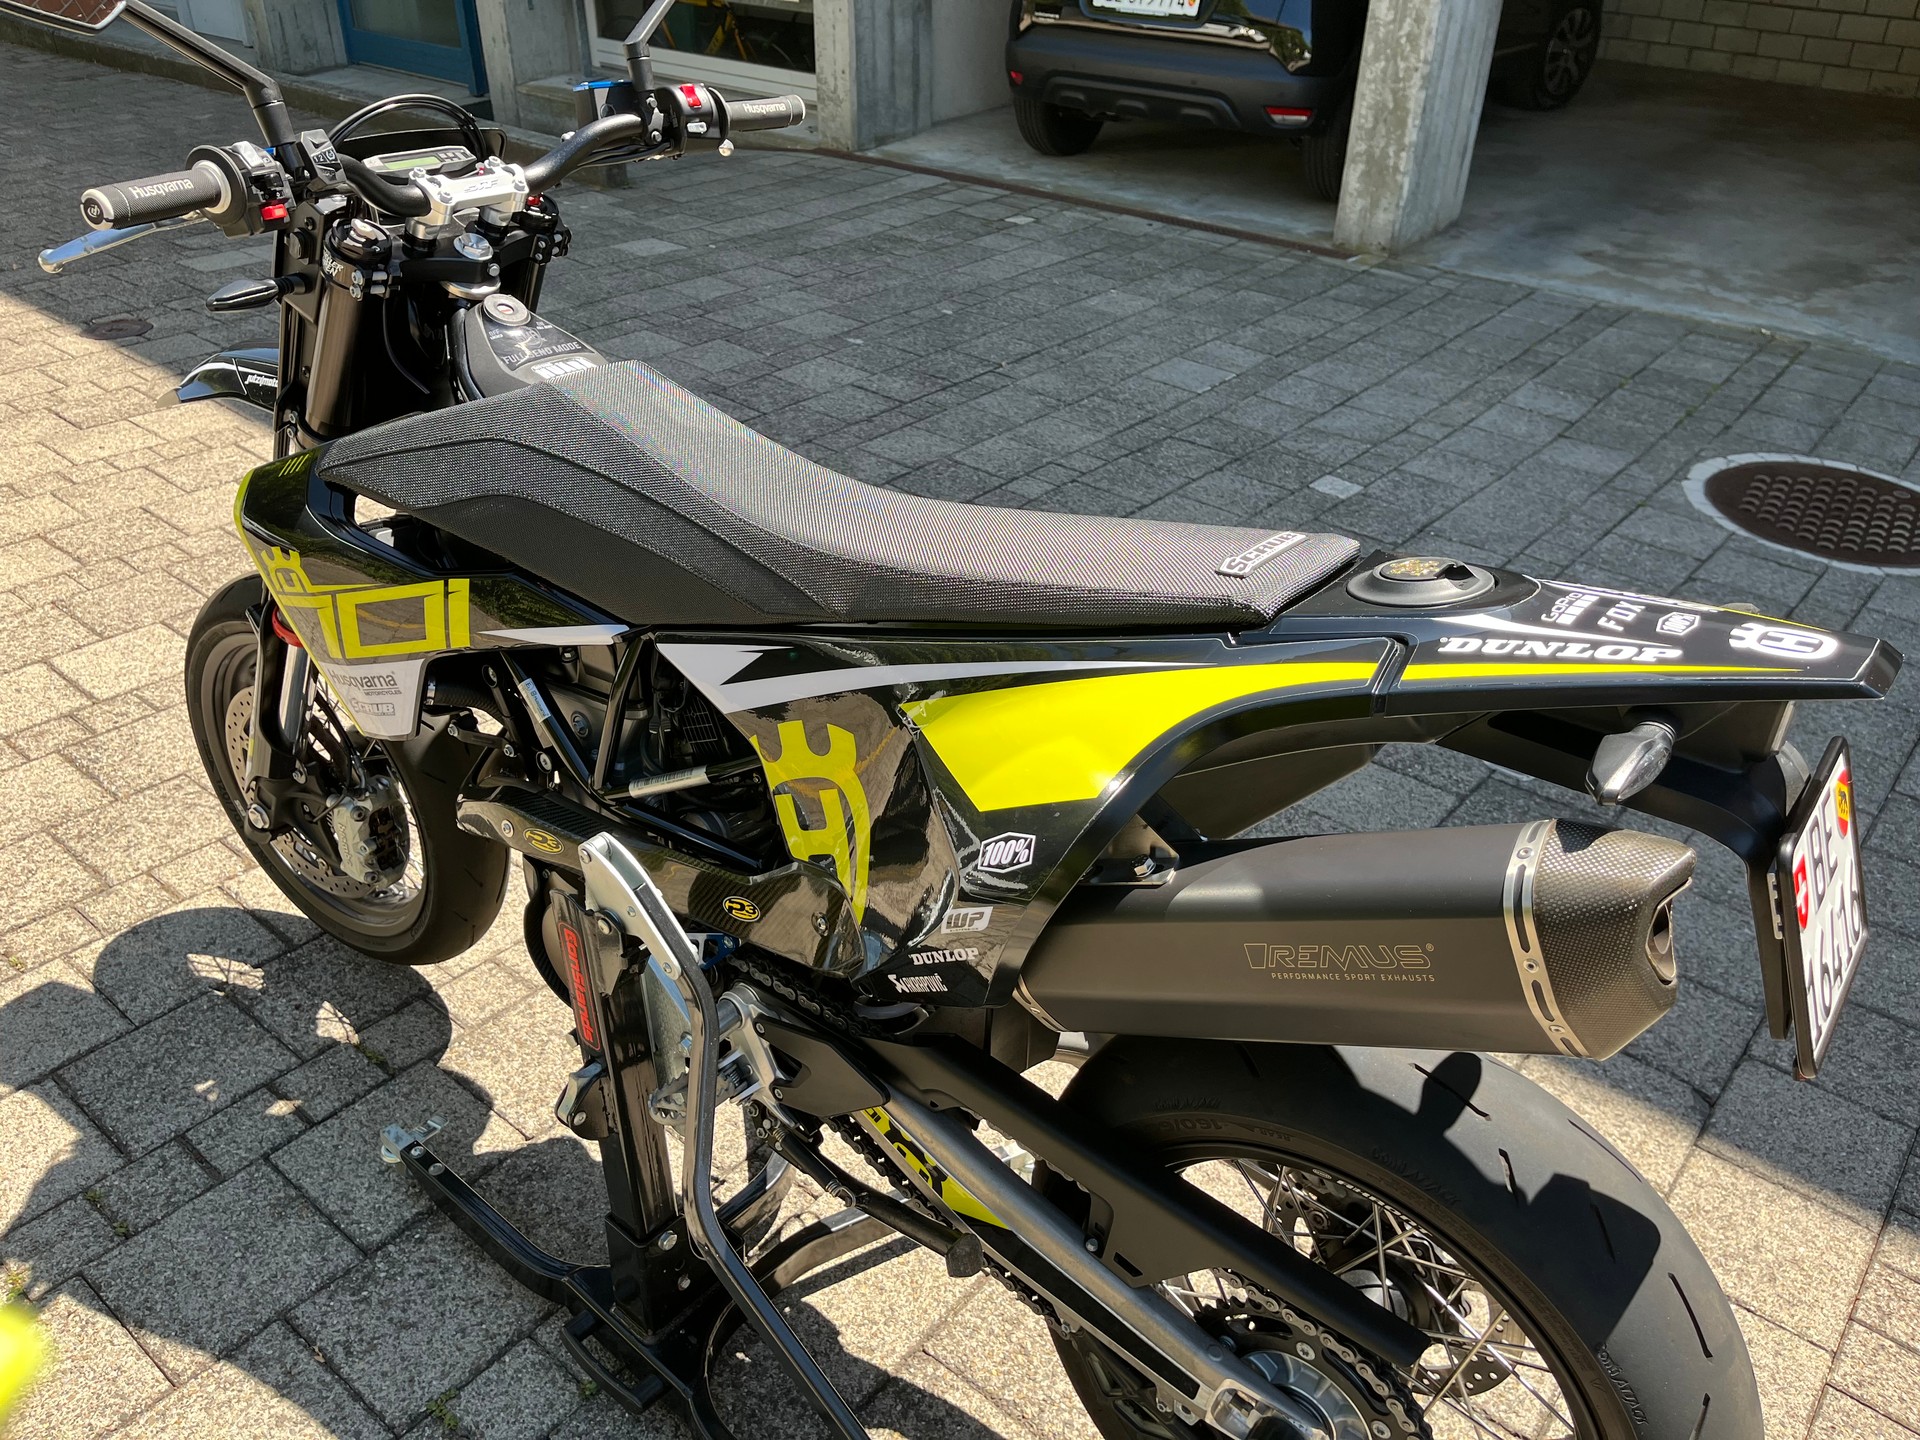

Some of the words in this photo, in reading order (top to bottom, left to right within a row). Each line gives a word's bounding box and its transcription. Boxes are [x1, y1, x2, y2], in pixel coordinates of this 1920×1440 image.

[742, 102, 787, 115] Husqvarna
[130, 177, 194, 200] Husqvarna
[553, 341, 582, 353] MODE
[1541, 592, 1583, 622] GoPro
[1597, 601, 1647, 632] FOX
[1438, 637, 1683, 662] DUNLOP
[326, 667, 398, 691] Husqvarna
[983, 838, 1030, 867] 100%
[1808, 786, 1838, 915] BE
[945, 911, 985, 930] WP
[910, 947, 980, 966] DUNLOP
[1268, 944, 1431, 971] REMUS
[1271, 972, 1341, 981] PERFORMANCE
[1344, 973, 1377, 981] SPORT
[1380, 973, 1435, 982] EXHAUSTS
